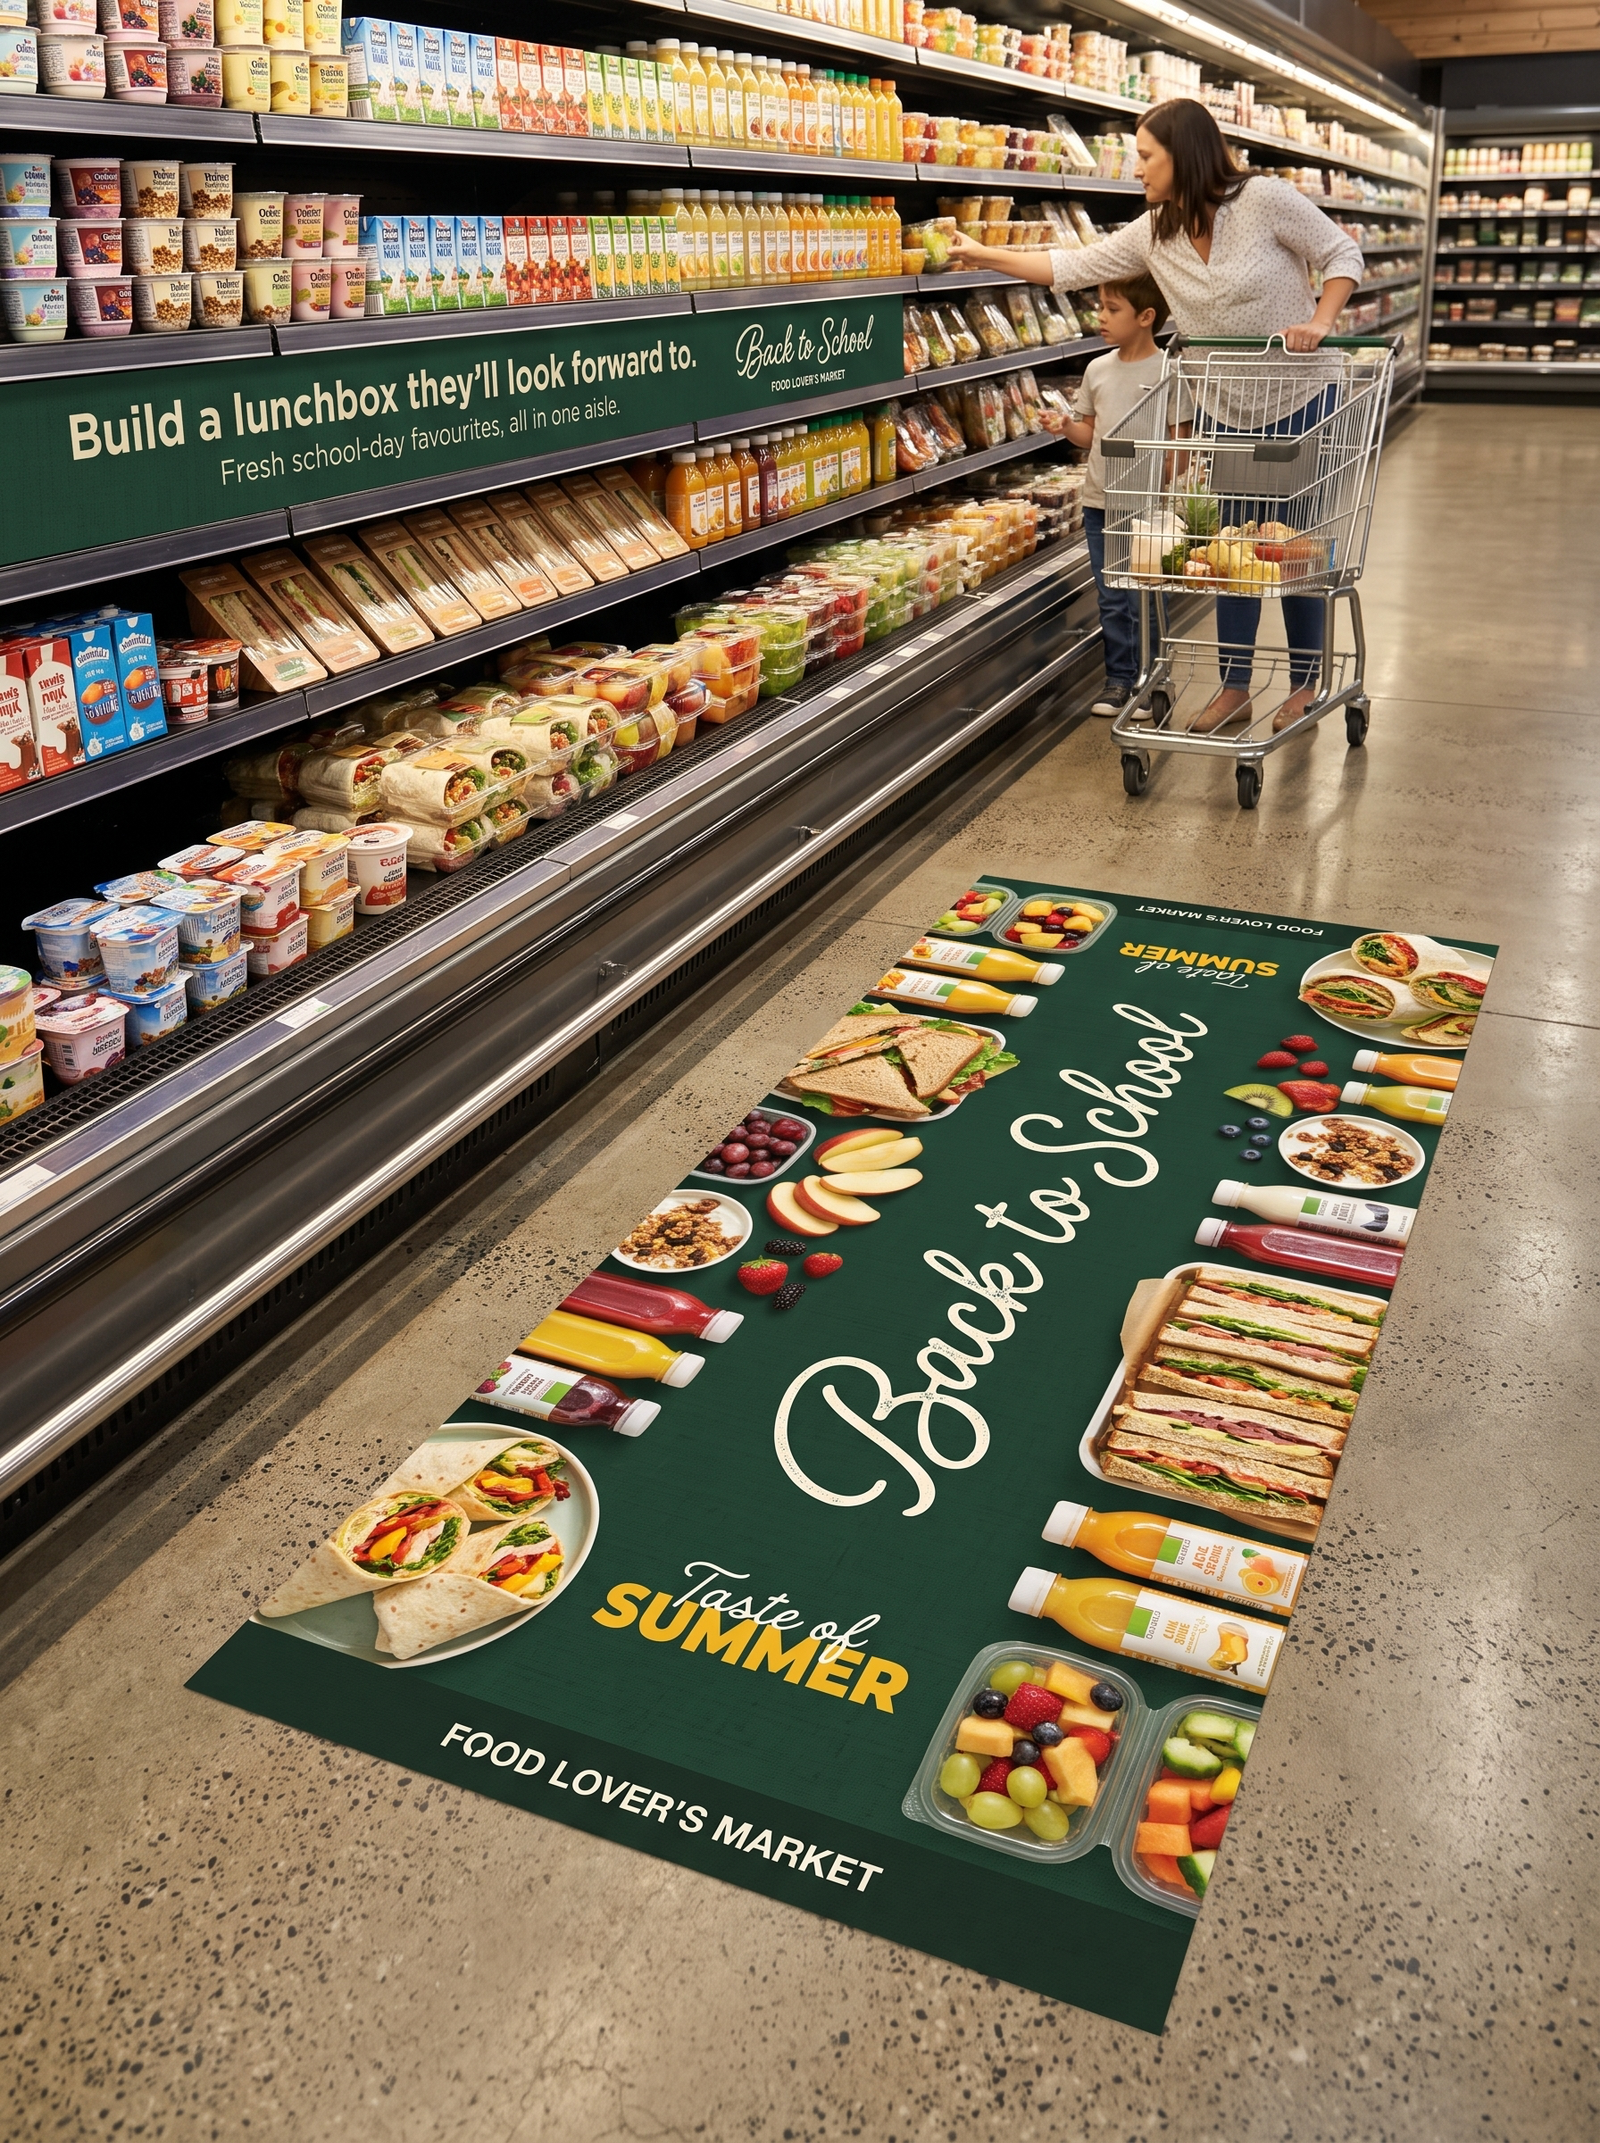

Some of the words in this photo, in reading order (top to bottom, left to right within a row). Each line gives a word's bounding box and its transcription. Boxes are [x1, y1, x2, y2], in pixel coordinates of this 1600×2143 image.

[735, 323, 795, 380] Back
[798, 328, 816, 361] to
[817, 314, 875, 365] School
[770, 380, 791, 393] FOOD
[792, 373, 819, 388] LOVER'S
[819, 368, 846, 383] MARKET
[69, 399, 186, 461] Build
[199, 406, 222, 442] a
[233, 378, 400, 437] lunchbox
[407, 360, 499, 411] they’ll
[508, 350, 565, 395] look
[571, 339, 663, 389] forward
[669, 341, 697, 371] to.
[221, 450, 285, 486] Fresh
[292, 430, 405, 473] school-day
[410, 413, 504, 451] favourites,
[508, 408, 528, 433] all
[533, 409, 548, 429] in
[550, 403, 581, 427] one
[584, 395, 622, 420] aisle.
[1135, 904, 1203, 920] MARKET
[1205, 914, 1274, 930] LOVER'S
[1276, 923, 1325, 937] FOOD
[1119, 942, 1281, 978] SUMMER
[1134, 960, 1172, 975] of
[1176, 965, 1250, 989] Taste
[1009, 1002, 1209, 1189] School
[974, 1175, 1092, 1245] to
[773, 1249, 1045, 1518] Back
[672, 1561, 805, 1631] Taste
[809, 1613, 882, 1664] of
[591, 1582, 910, 1714] SUMMER
[440, 1722, 546, 1776] FOOD
[547, 1760, 708, 1834] LOVER'S
[711, 1813, 885, 1893] MARKET
